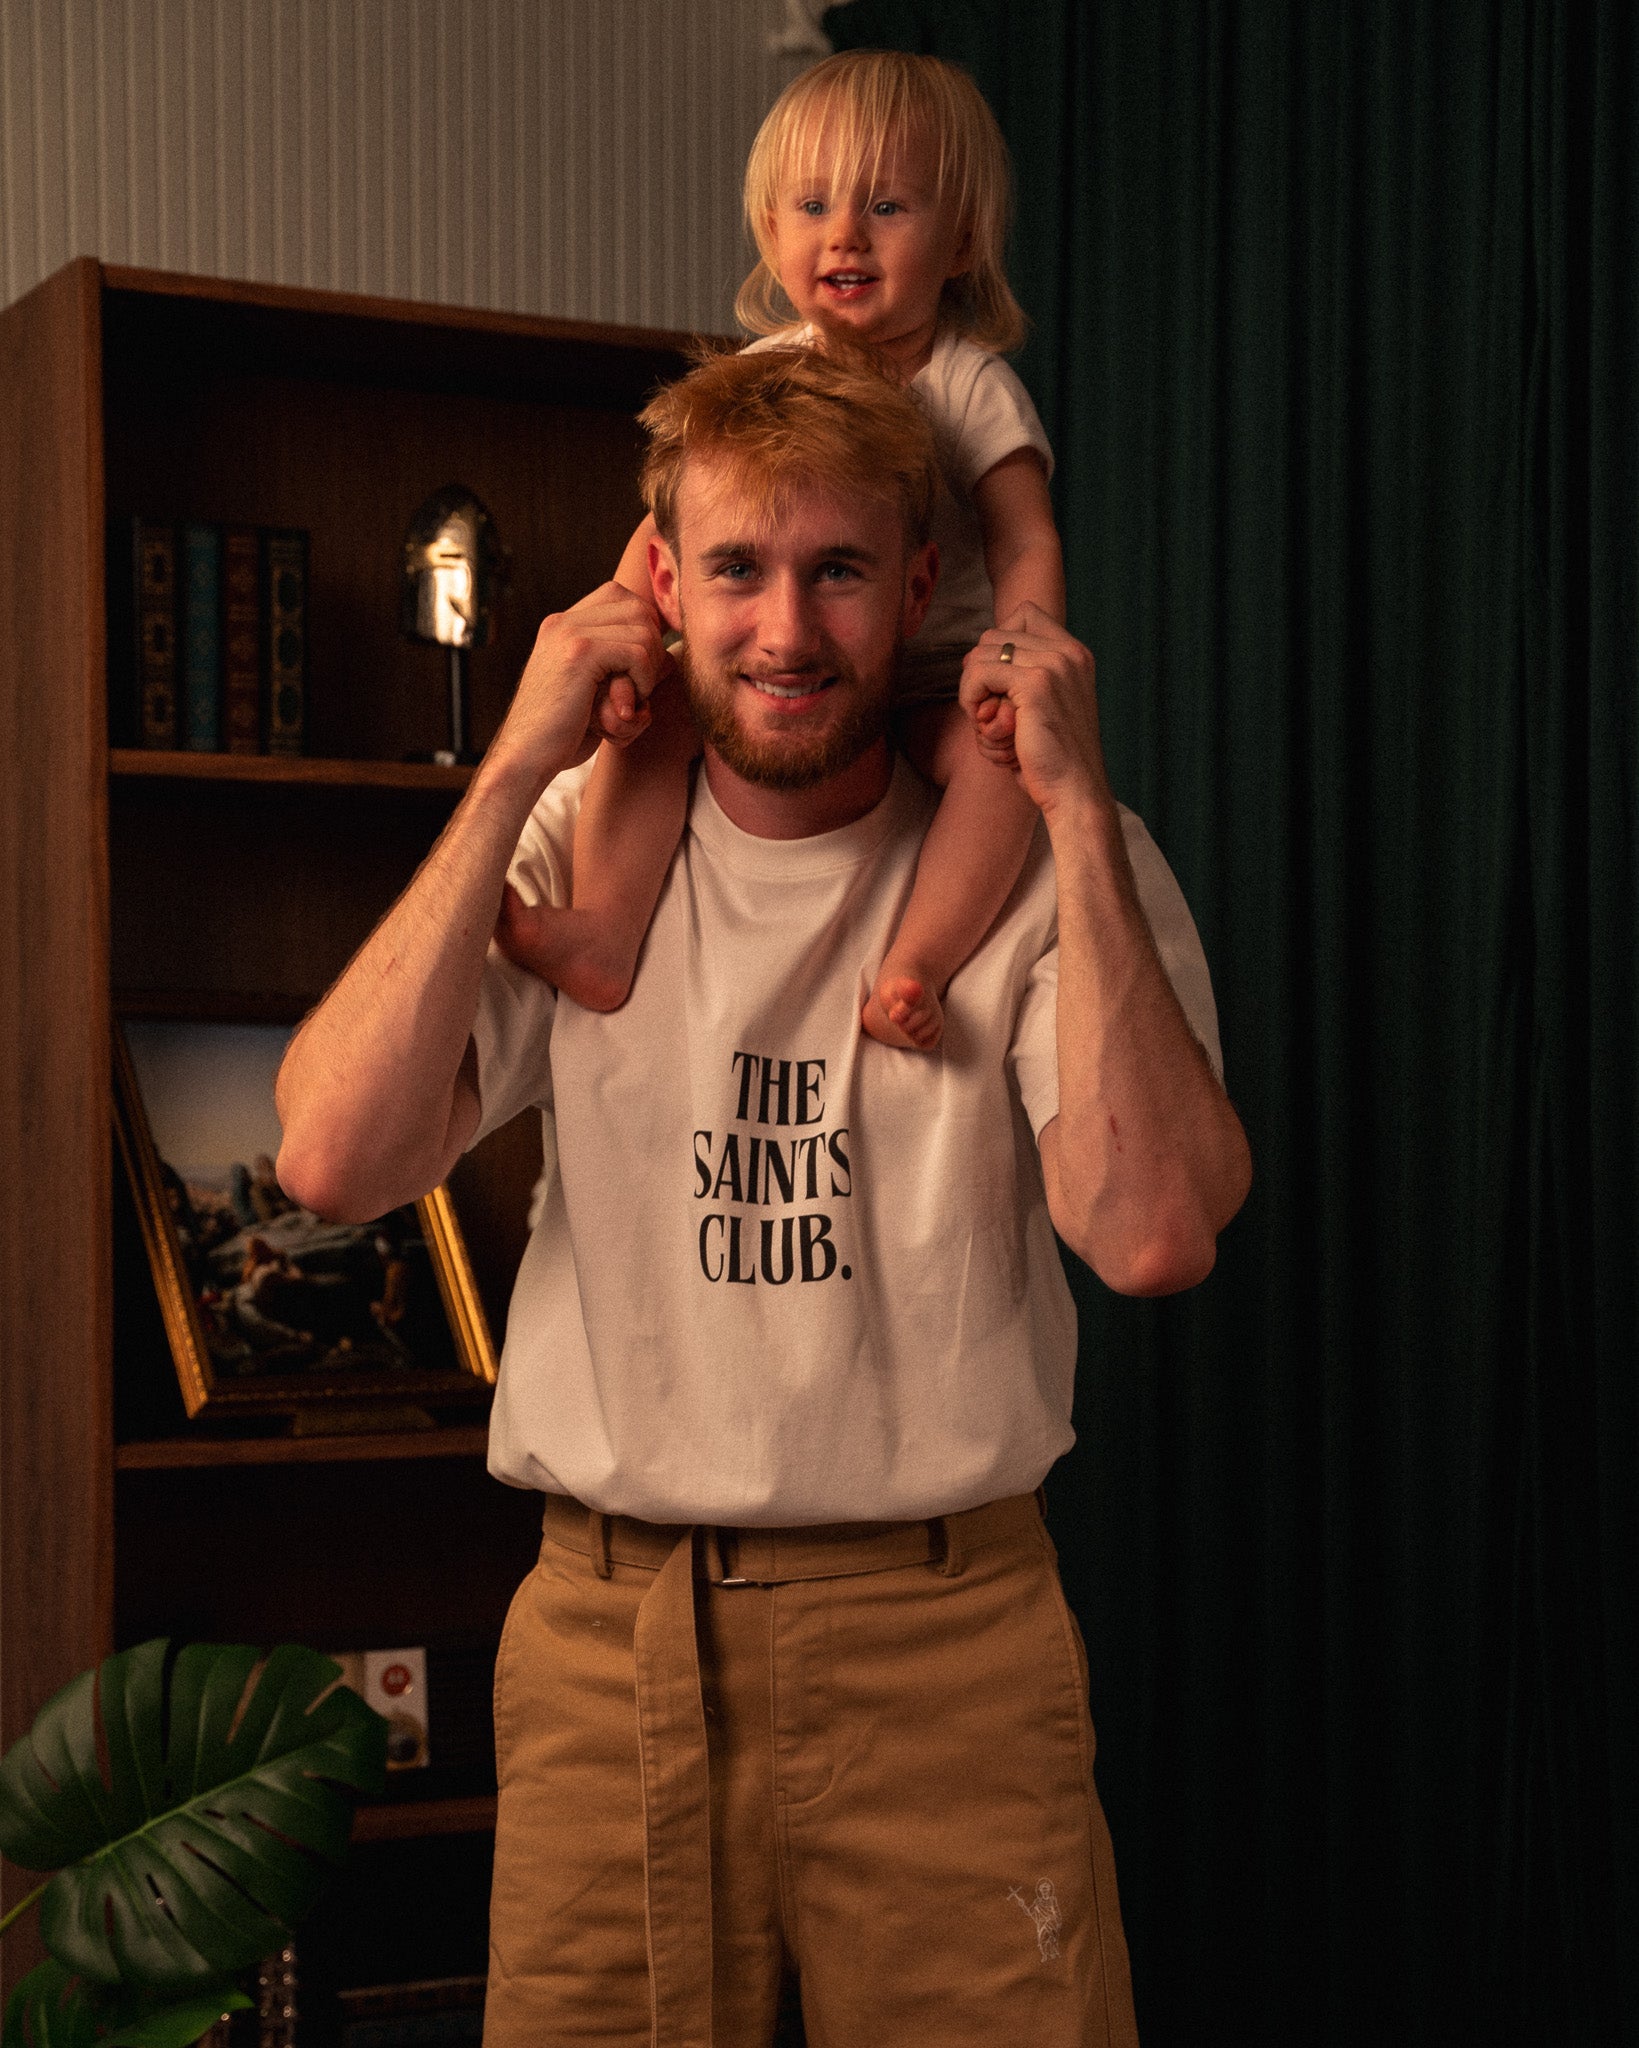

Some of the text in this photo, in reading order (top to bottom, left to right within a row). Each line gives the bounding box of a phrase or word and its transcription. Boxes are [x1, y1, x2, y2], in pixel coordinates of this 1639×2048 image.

[731, 1051, 827, 1126] THE
[693, 1128, 852, 1206] SAINTS
[698, 1213, 853, 1285] CLUB.
